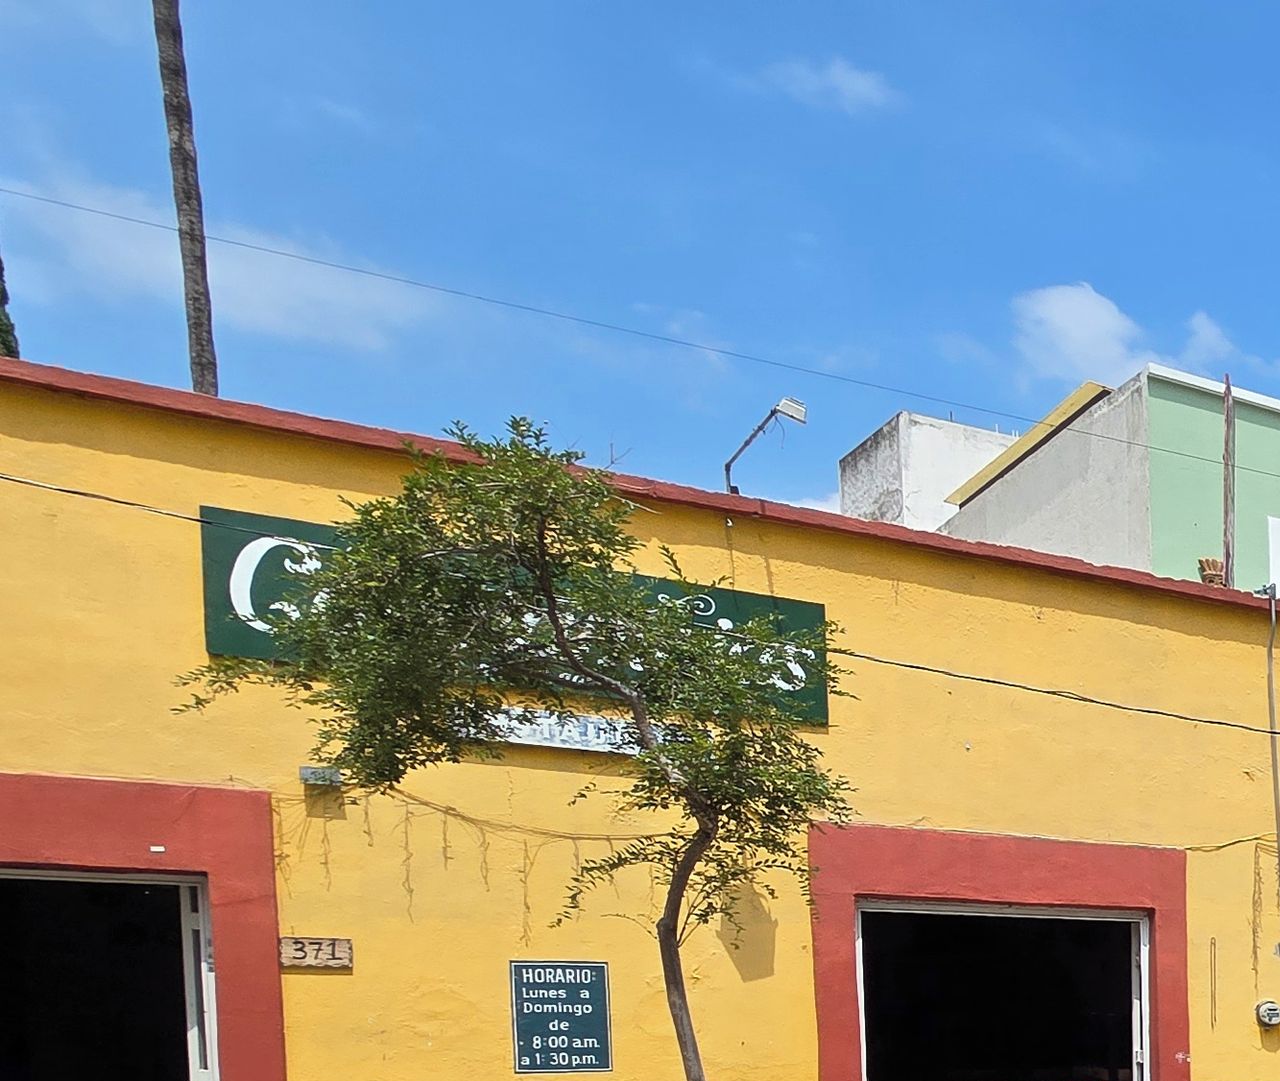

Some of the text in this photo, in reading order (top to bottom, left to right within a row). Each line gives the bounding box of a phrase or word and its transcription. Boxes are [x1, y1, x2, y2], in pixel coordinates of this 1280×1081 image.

[292, 940, 344, 960] 371
[522, 987, 590, 999] Lunes a
[523, 1002, 593, 1016] Domingo
[548, 1019, 570, 1031] de
[532, 1035, 568, 1049] 8:00
[520, 1055, 530, 1065] a
